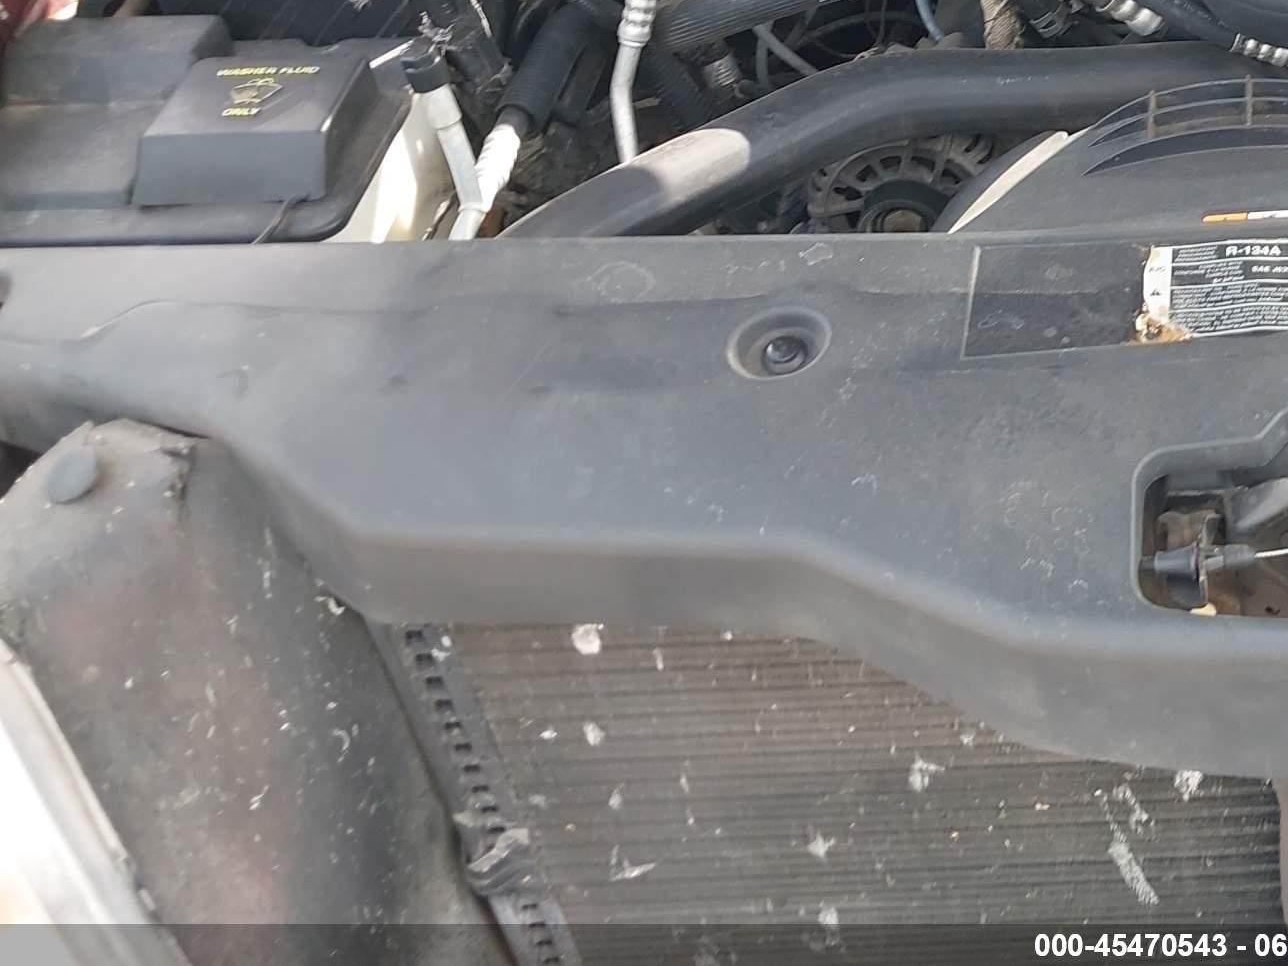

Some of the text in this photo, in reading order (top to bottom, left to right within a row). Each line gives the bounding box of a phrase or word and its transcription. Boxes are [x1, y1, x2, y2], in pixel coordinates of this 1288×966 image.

[217, 65, 320, 76] WASHER FLUID
[221, 107, 261, 116] ONLY
[1225, 245, 1281, 257] R-134A
